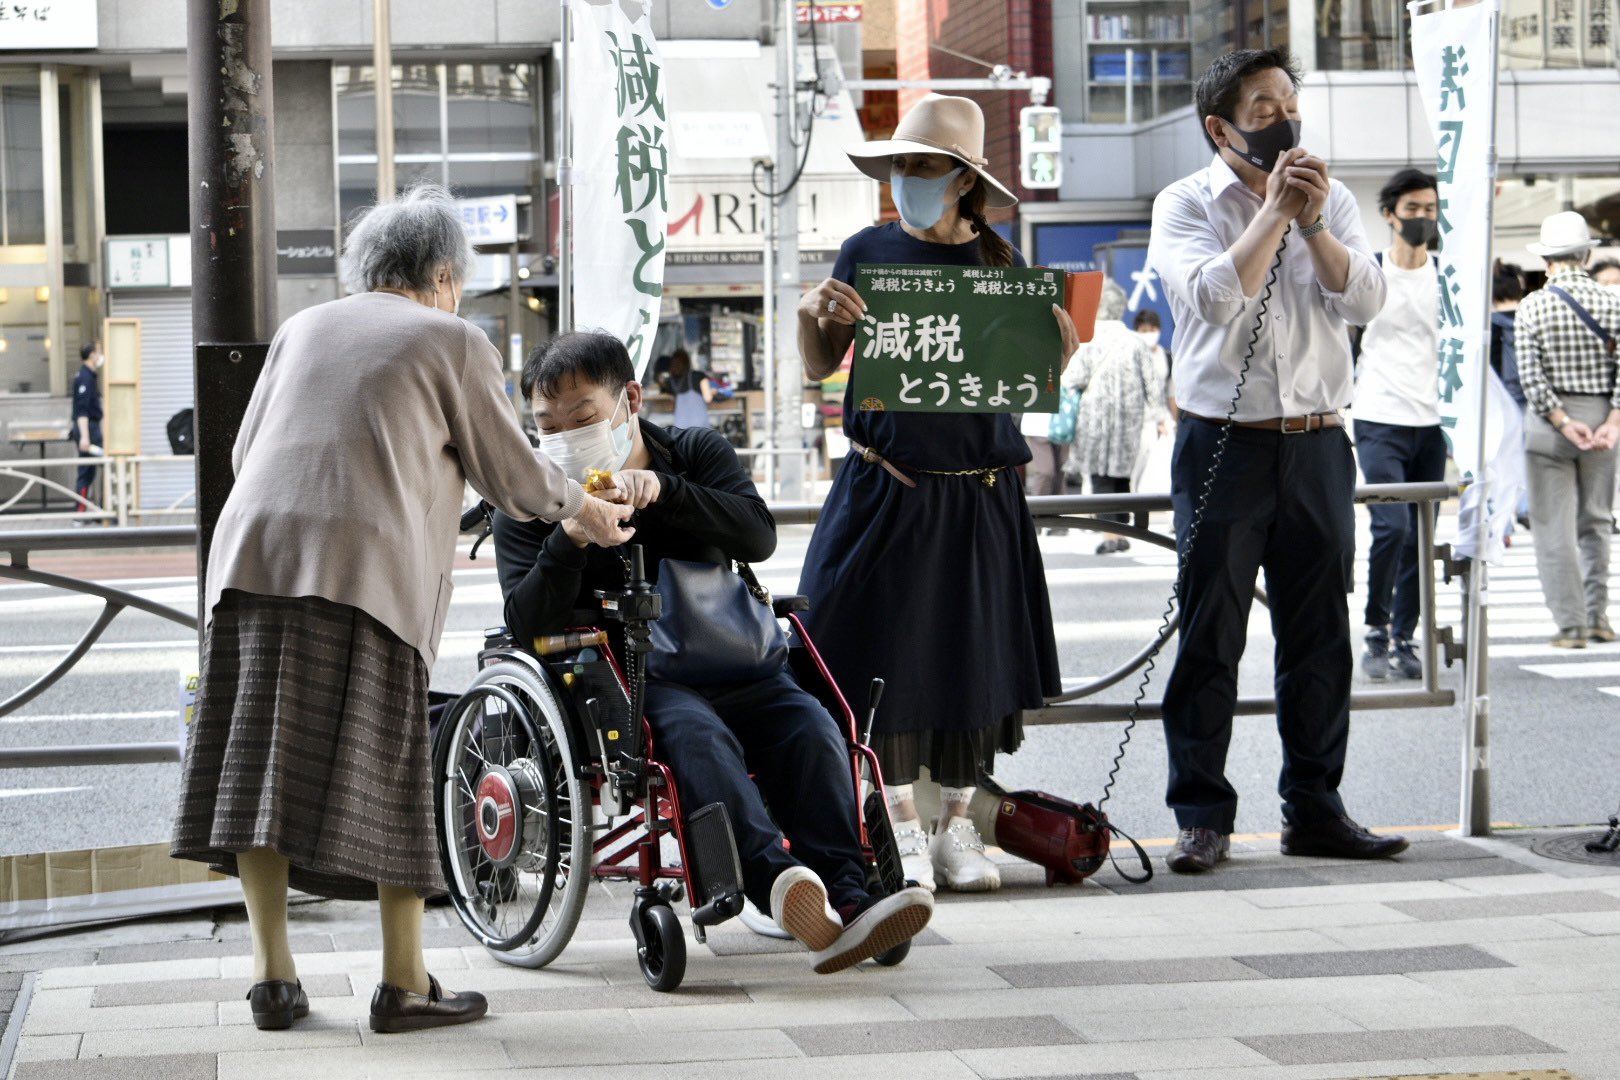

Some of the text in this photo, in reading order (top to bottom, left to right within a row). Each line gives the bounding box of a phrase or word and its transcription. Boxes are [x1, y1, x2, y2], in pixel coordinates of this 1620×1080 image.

[962, 269, 1004, 279] 減税しよう!
[871, 277, 955, 293] 減税とうきょう
[973, 280, 1058, 296] 減税とうきょう
[862, 312, 964, 363] 減税
[899, 372, 1039, 408] とうきょう
